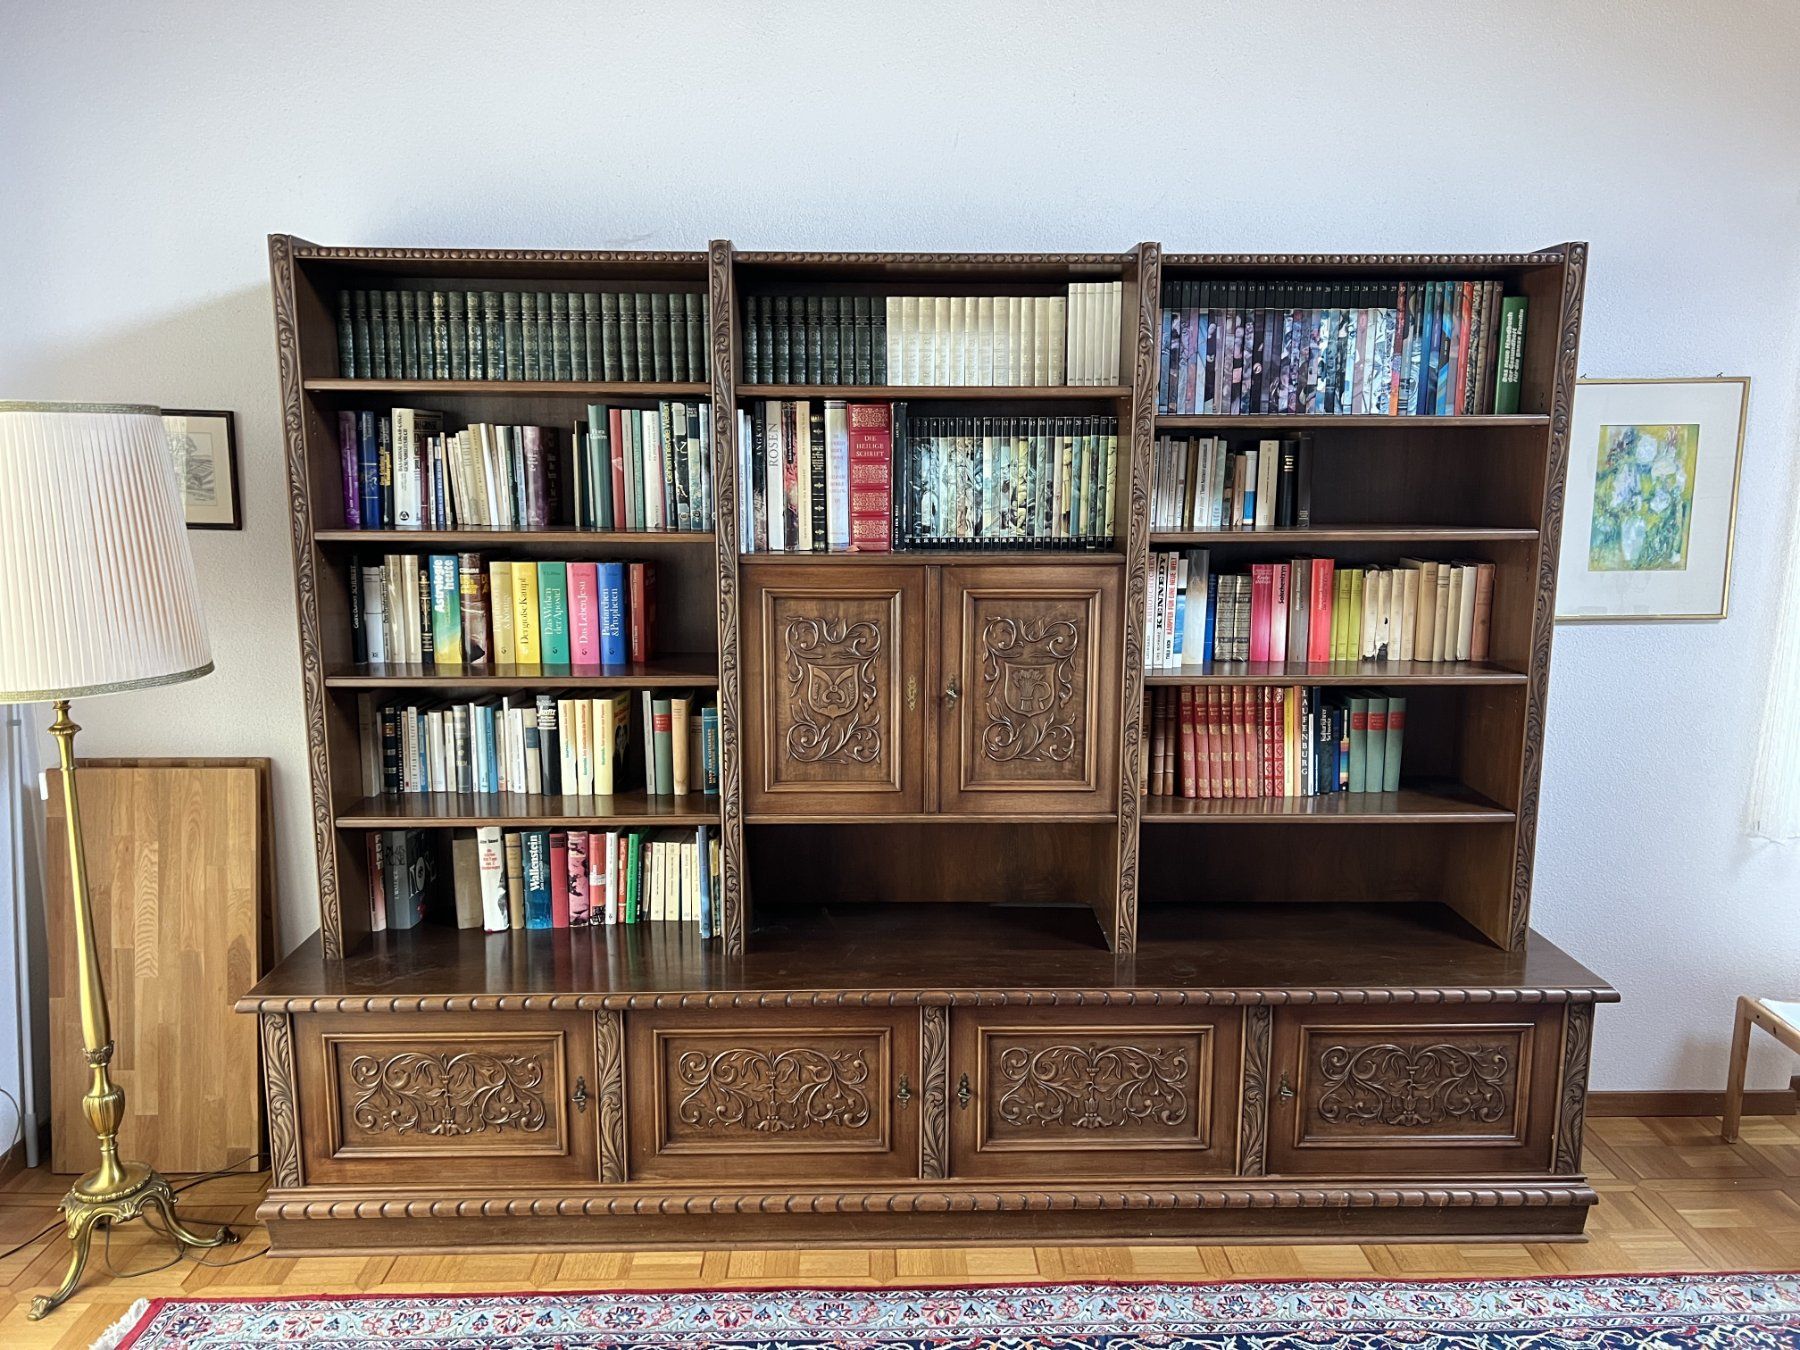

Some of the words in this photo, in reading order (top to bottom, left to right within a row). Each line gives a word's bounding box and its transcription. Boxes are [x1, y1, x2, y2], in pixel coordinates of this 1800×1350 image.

[1504, 312, 1513, 349] Handbuch
[1508, 327, 1517, 369] Gesundheit
[662, 402, 670, 428] Welten
[755, 418, 763, 456] ANGKOR
[768, 423, 778, 466] ROSEN
[664, 429, 673, 484] Geheimnisvolle
[432, 559, 445, 613] Astrologie
[444, 559, 454, 590] heute
[1168, 572, 1176, 586] NEUE
[518, 578, 529, 604] Kampf
[544, 588, 552, 619] Wirken
[552, 588, 563, 620] Apostel
[578, 581, 588, 600] Jesu
[1156, 556, 1166, 630] KENNEDY
[1166, 600, 1174, 610] FÜR
[544, 619, 554, 635] Das
[578, 600, 588, 626] Leben
[602, 588, 610, 636] Patriarchen
[1165, 610, 1174, 635] KÄMPFER
[579, 628, 588, 644] Das
[528, 835, 540, 892] Wallenstein
